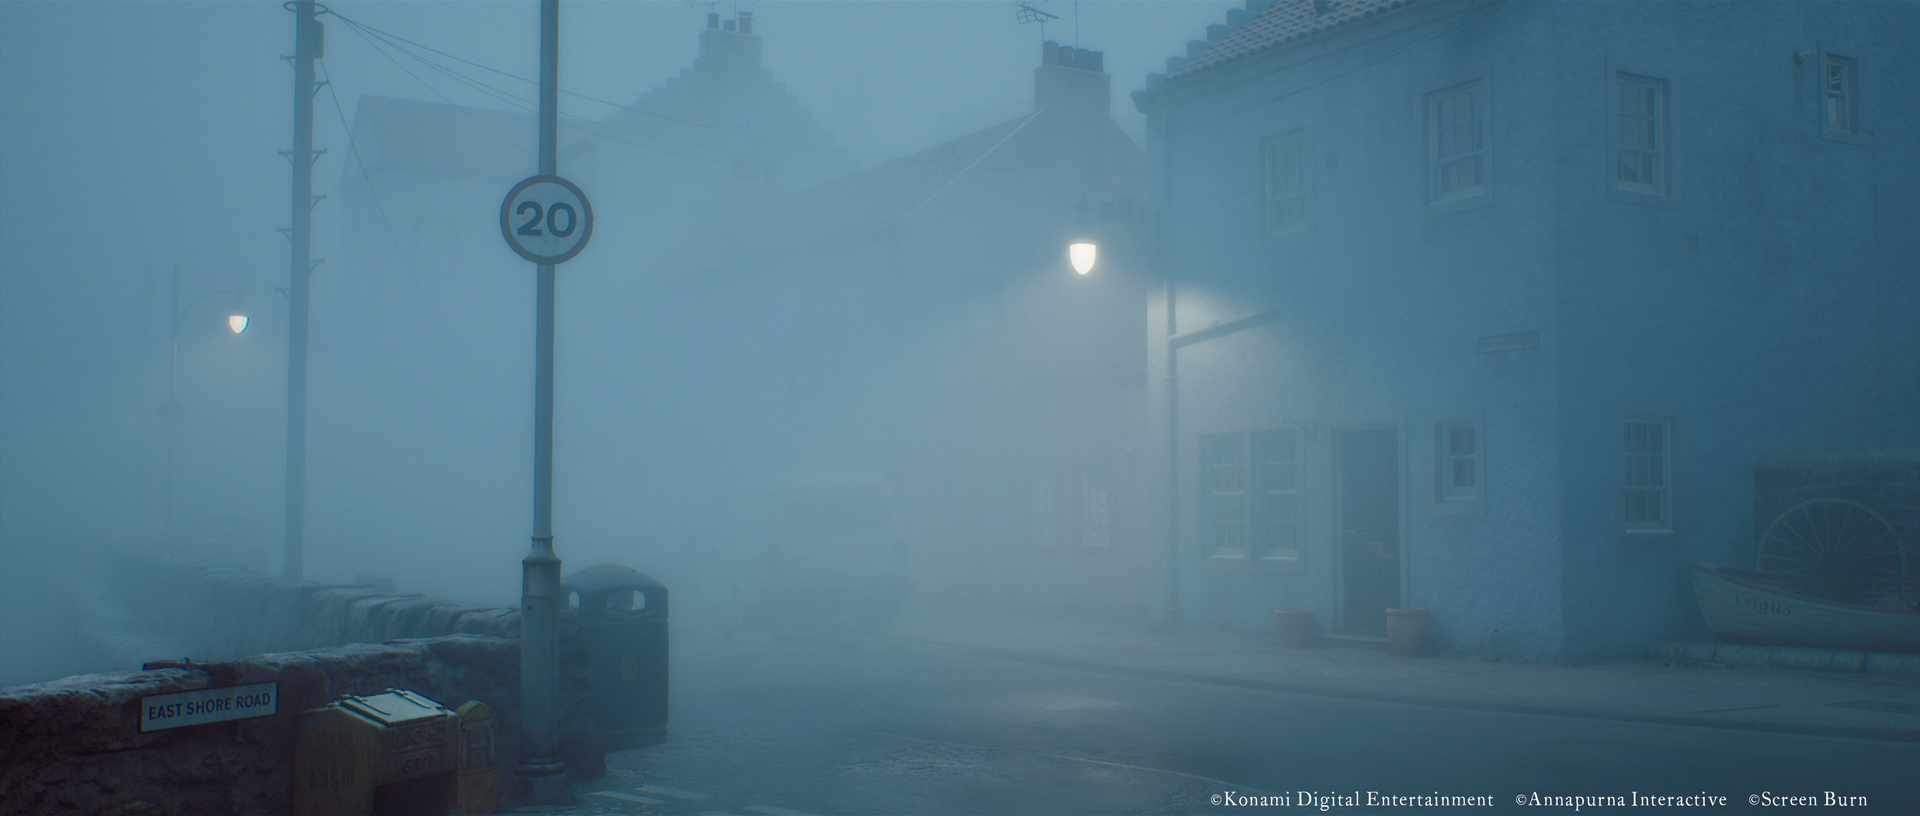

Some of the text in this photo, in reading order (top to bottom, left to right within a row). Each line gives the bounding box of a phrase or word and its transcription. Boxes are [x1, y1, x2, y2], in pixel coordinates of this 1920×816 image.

[516, 200, 577, 238] 20
[1730, 588, 1793, 616] Fergus
[148, 692, 271, 721] EAST SHORE ROAD
